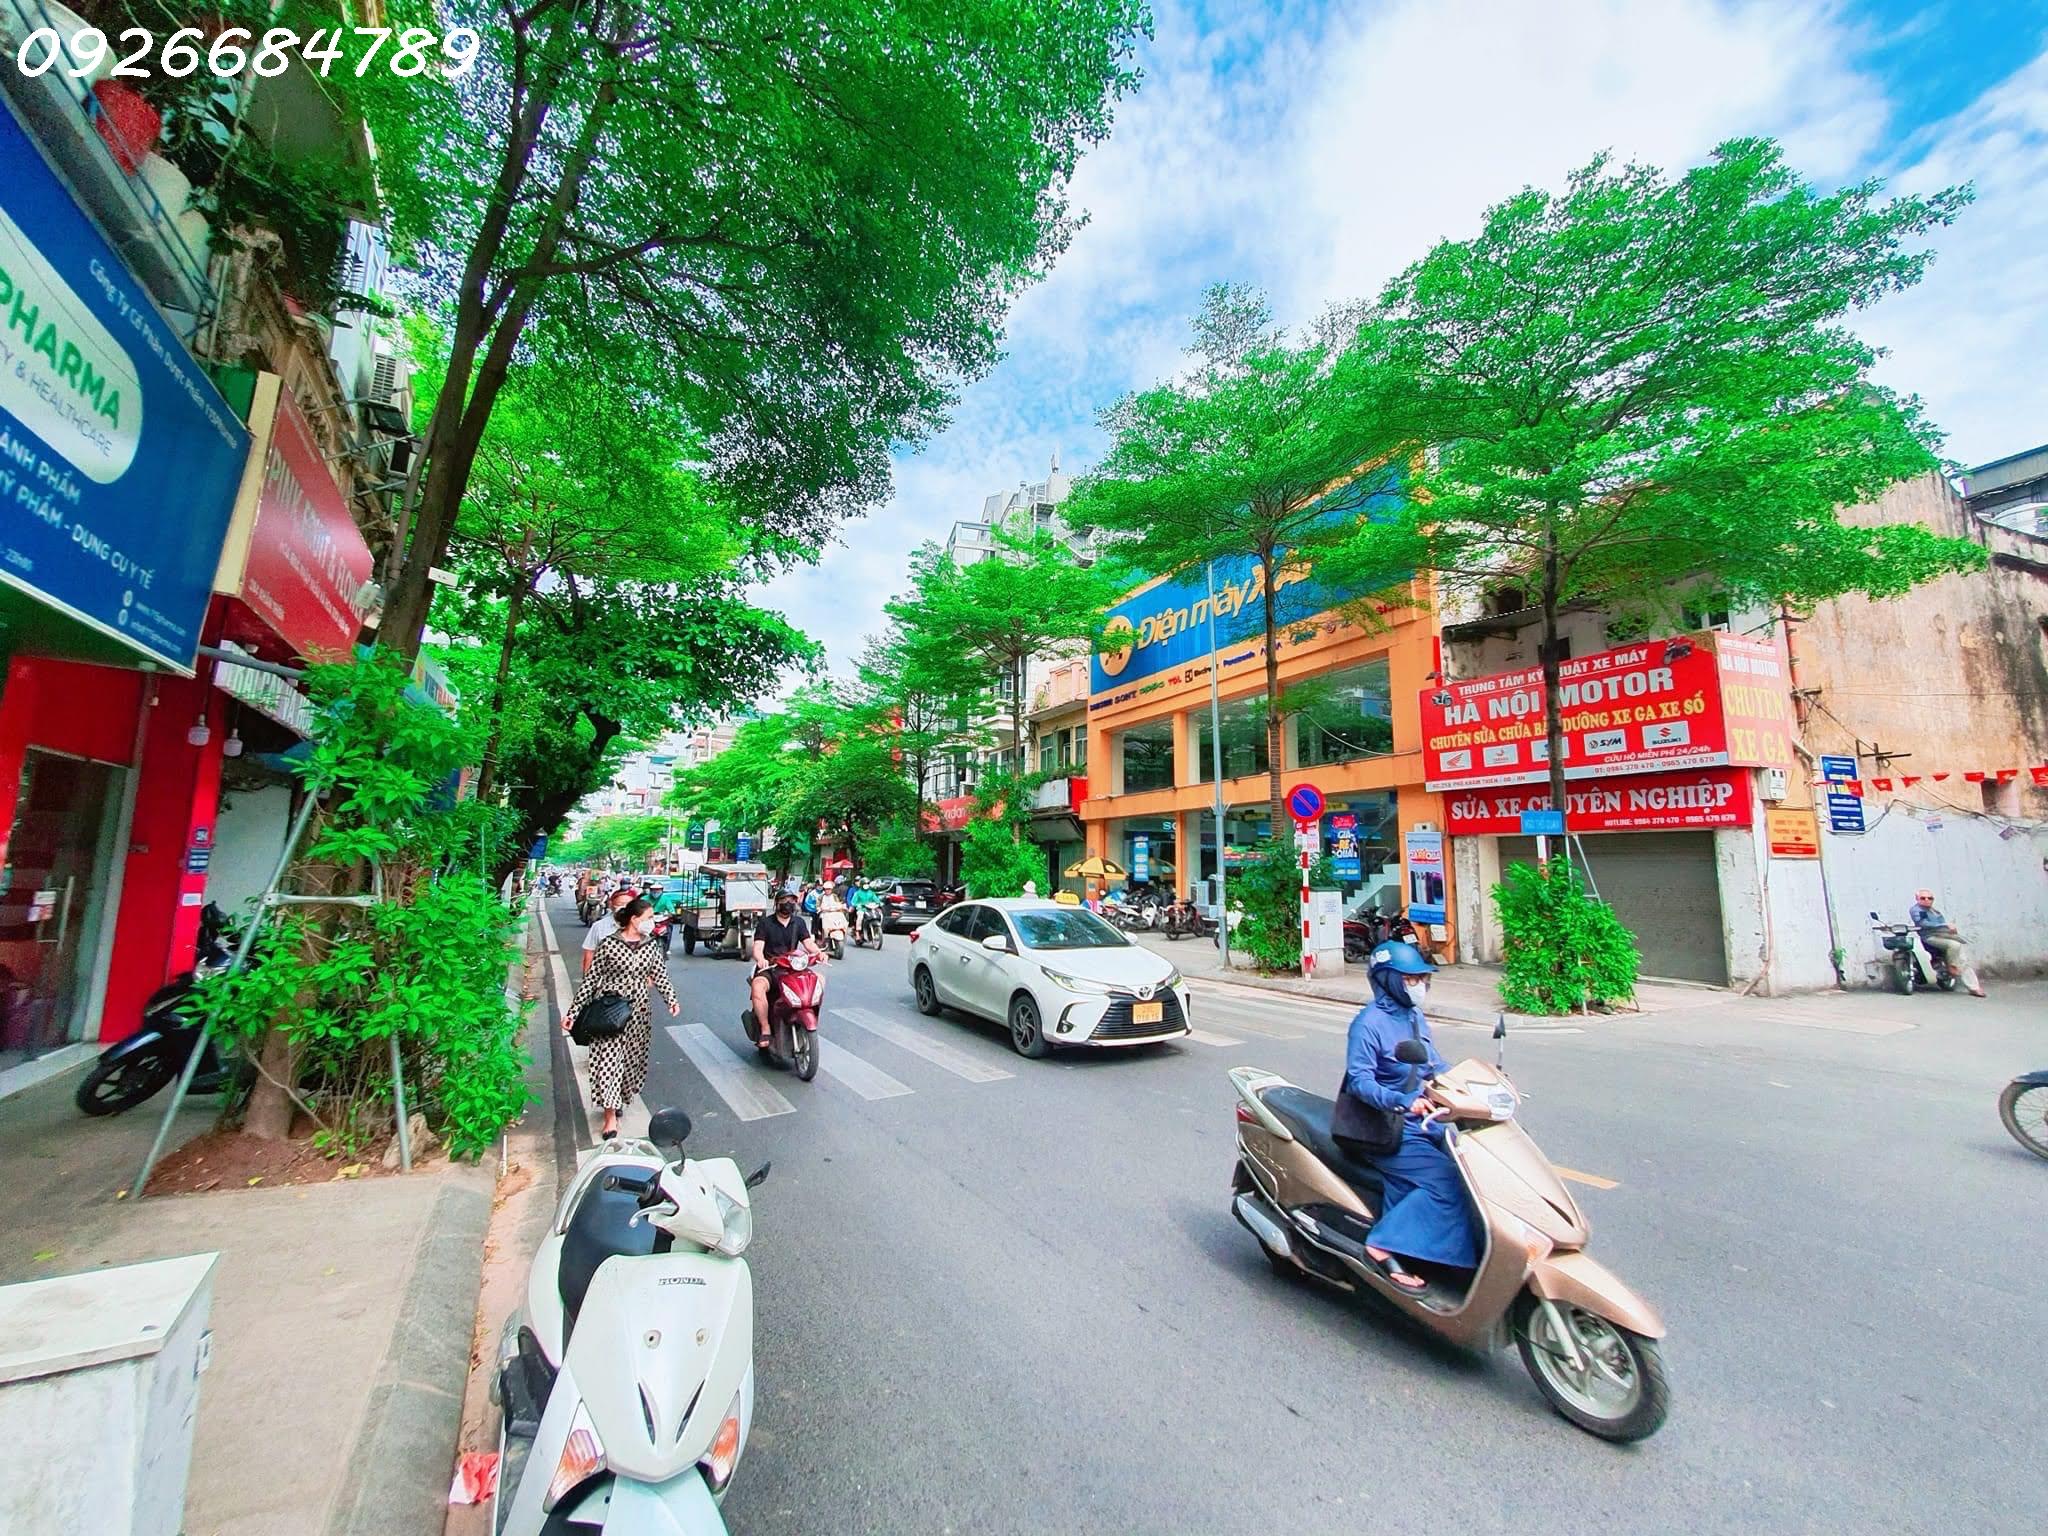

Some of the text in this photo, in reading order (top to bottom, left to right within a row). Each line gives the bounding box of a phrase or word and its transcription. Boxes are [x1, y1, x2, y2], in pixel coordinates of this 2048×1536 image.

[30, 371, 113, 458] HEALTHCARE
[37, 460, 82, 505] PHẨM
[16, 484, 64, 529] PHẨM
[71, 523, 111, 561] DỤNG
[111, 551, 129, 577] CỤ
[129, 561, 141, 579] Y
[139, 568, 156, 590] TẾ
[1138, 607, 1186, 650] Điện
[1189, 578, 1251, 627] máy
[1458, 680, 1496, 696] TRUNG
[1499, 674, 1525, 689] TÂM
[1593, 656, 1611, 671] XE
[1615, 648, 1649, 666] MÁY
[1444, 666, 1675, 727] HÀ NỘI MOTOR
[1429, 730, 1473, 751] CHUYÊN
[1473, 724, 1497, 745] SỬA
[1498, 720, 1532, 742] CHỮA
[1562, 711, 1610, 733] DƯỠNG
[1611, 708, 1632, 726] XE
[1634, 704, 1657, 722] GA
[1659, 700, 1681, 718] XE
[1683, 690, 1706, 715] SỐ
[1599, 737, 1623, 747] SYM
[1651, 736, 1682, 746] SUZUKI
[1660, 747, 1675, 759] PHÍ
[1732, 727, 1792, 765] XE GA
[1451, 793, 1490, 820] SỬA
[1495, 797, 1522, 818] XE
[1628, 777, 1734, 814] NGHIỆP
